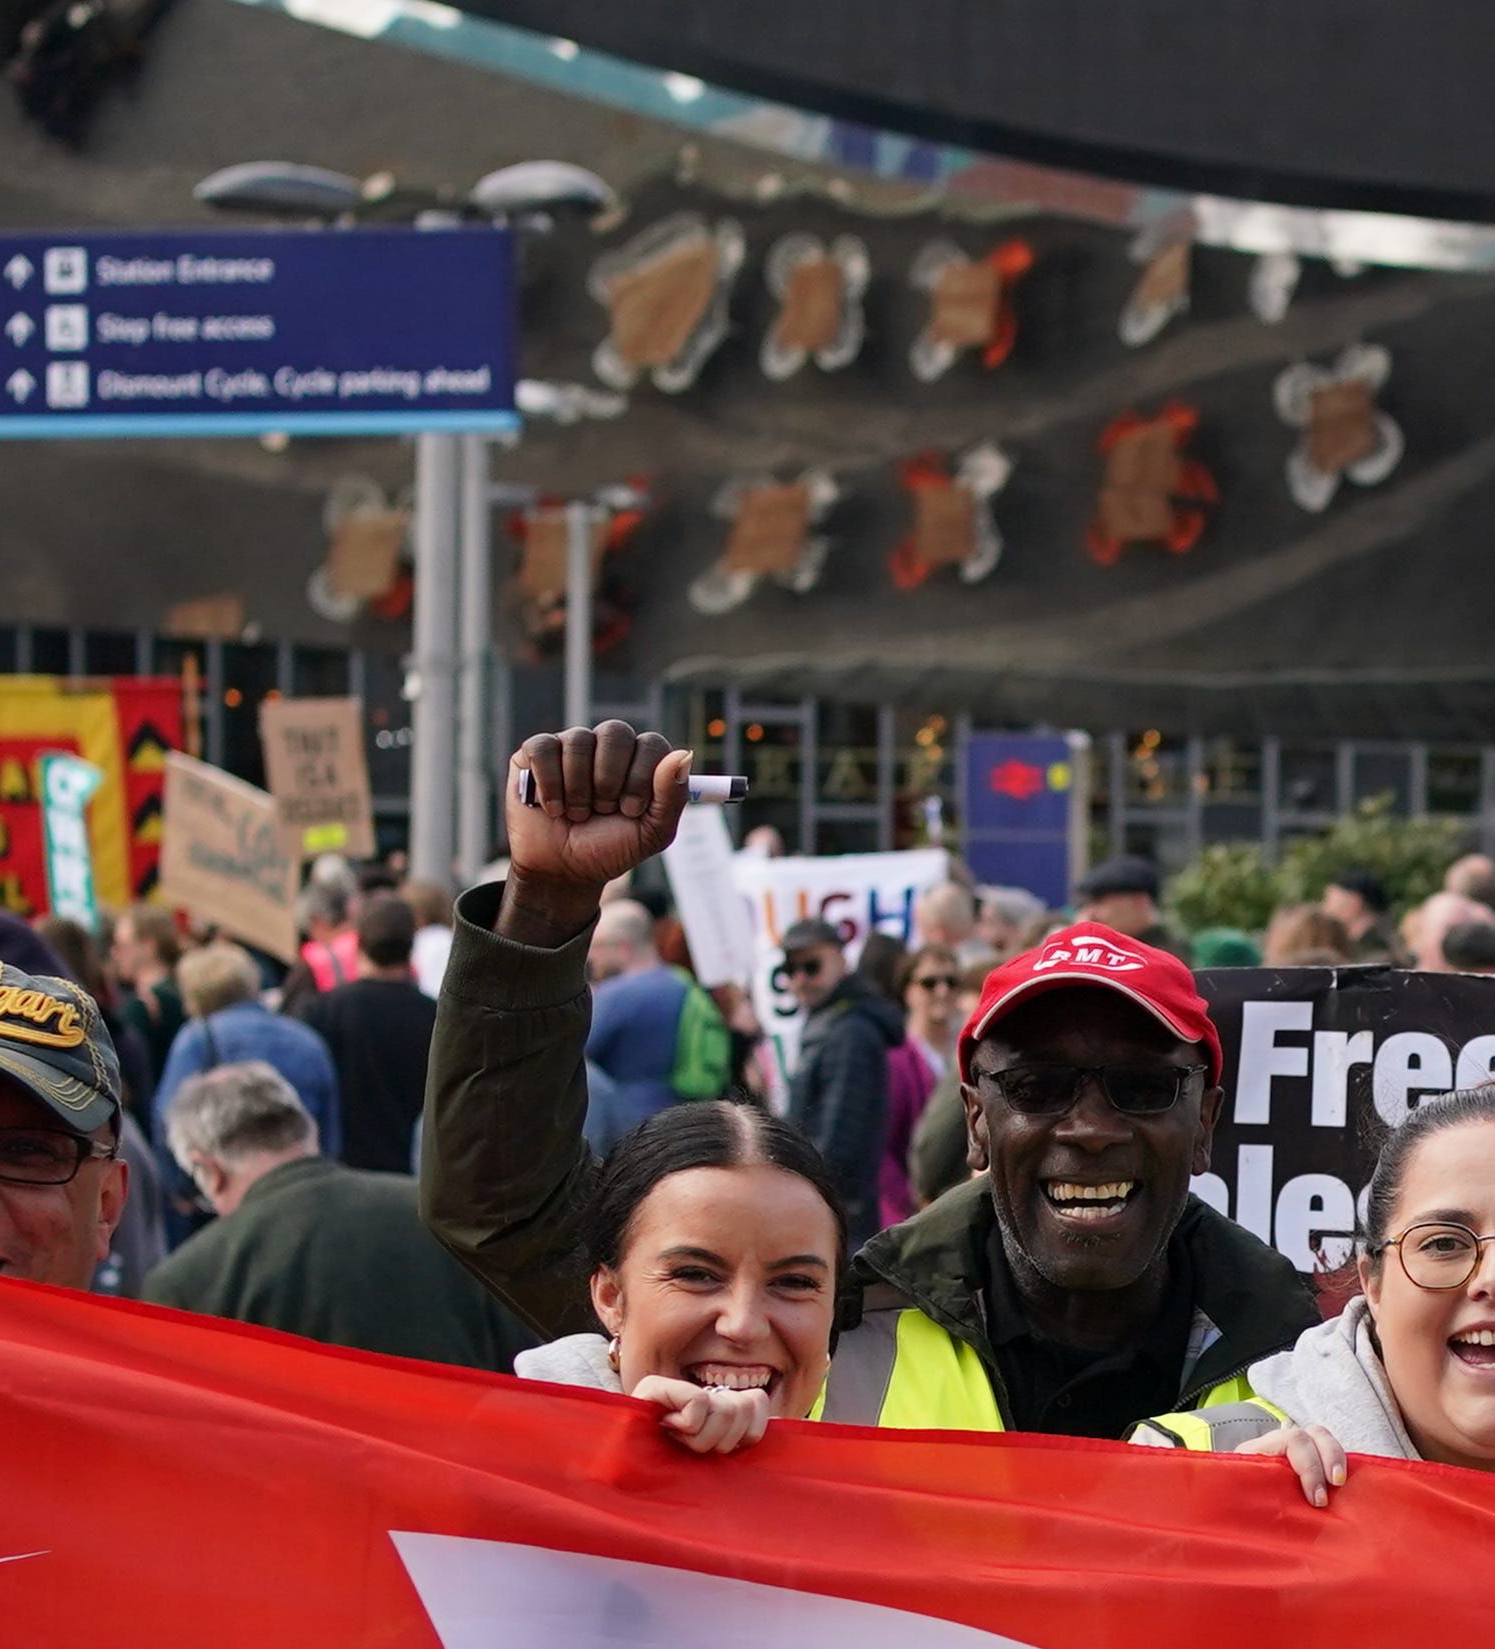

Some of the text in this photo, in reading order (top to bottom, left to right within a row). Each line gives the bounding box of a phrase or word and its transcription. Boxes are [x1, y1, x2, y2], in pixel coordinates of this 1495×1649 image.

[96, 255, 274, 285] Station Entrance
[97, 312, 274, 345] Step free access
[97, 370, 201, 399] Dismount
[274, 367, 334, 398] Cycle
[338, 368, 421, 398] parking
[424, 366, 490, 395] ahead
[1050, 948, 1126, 966] RMT
